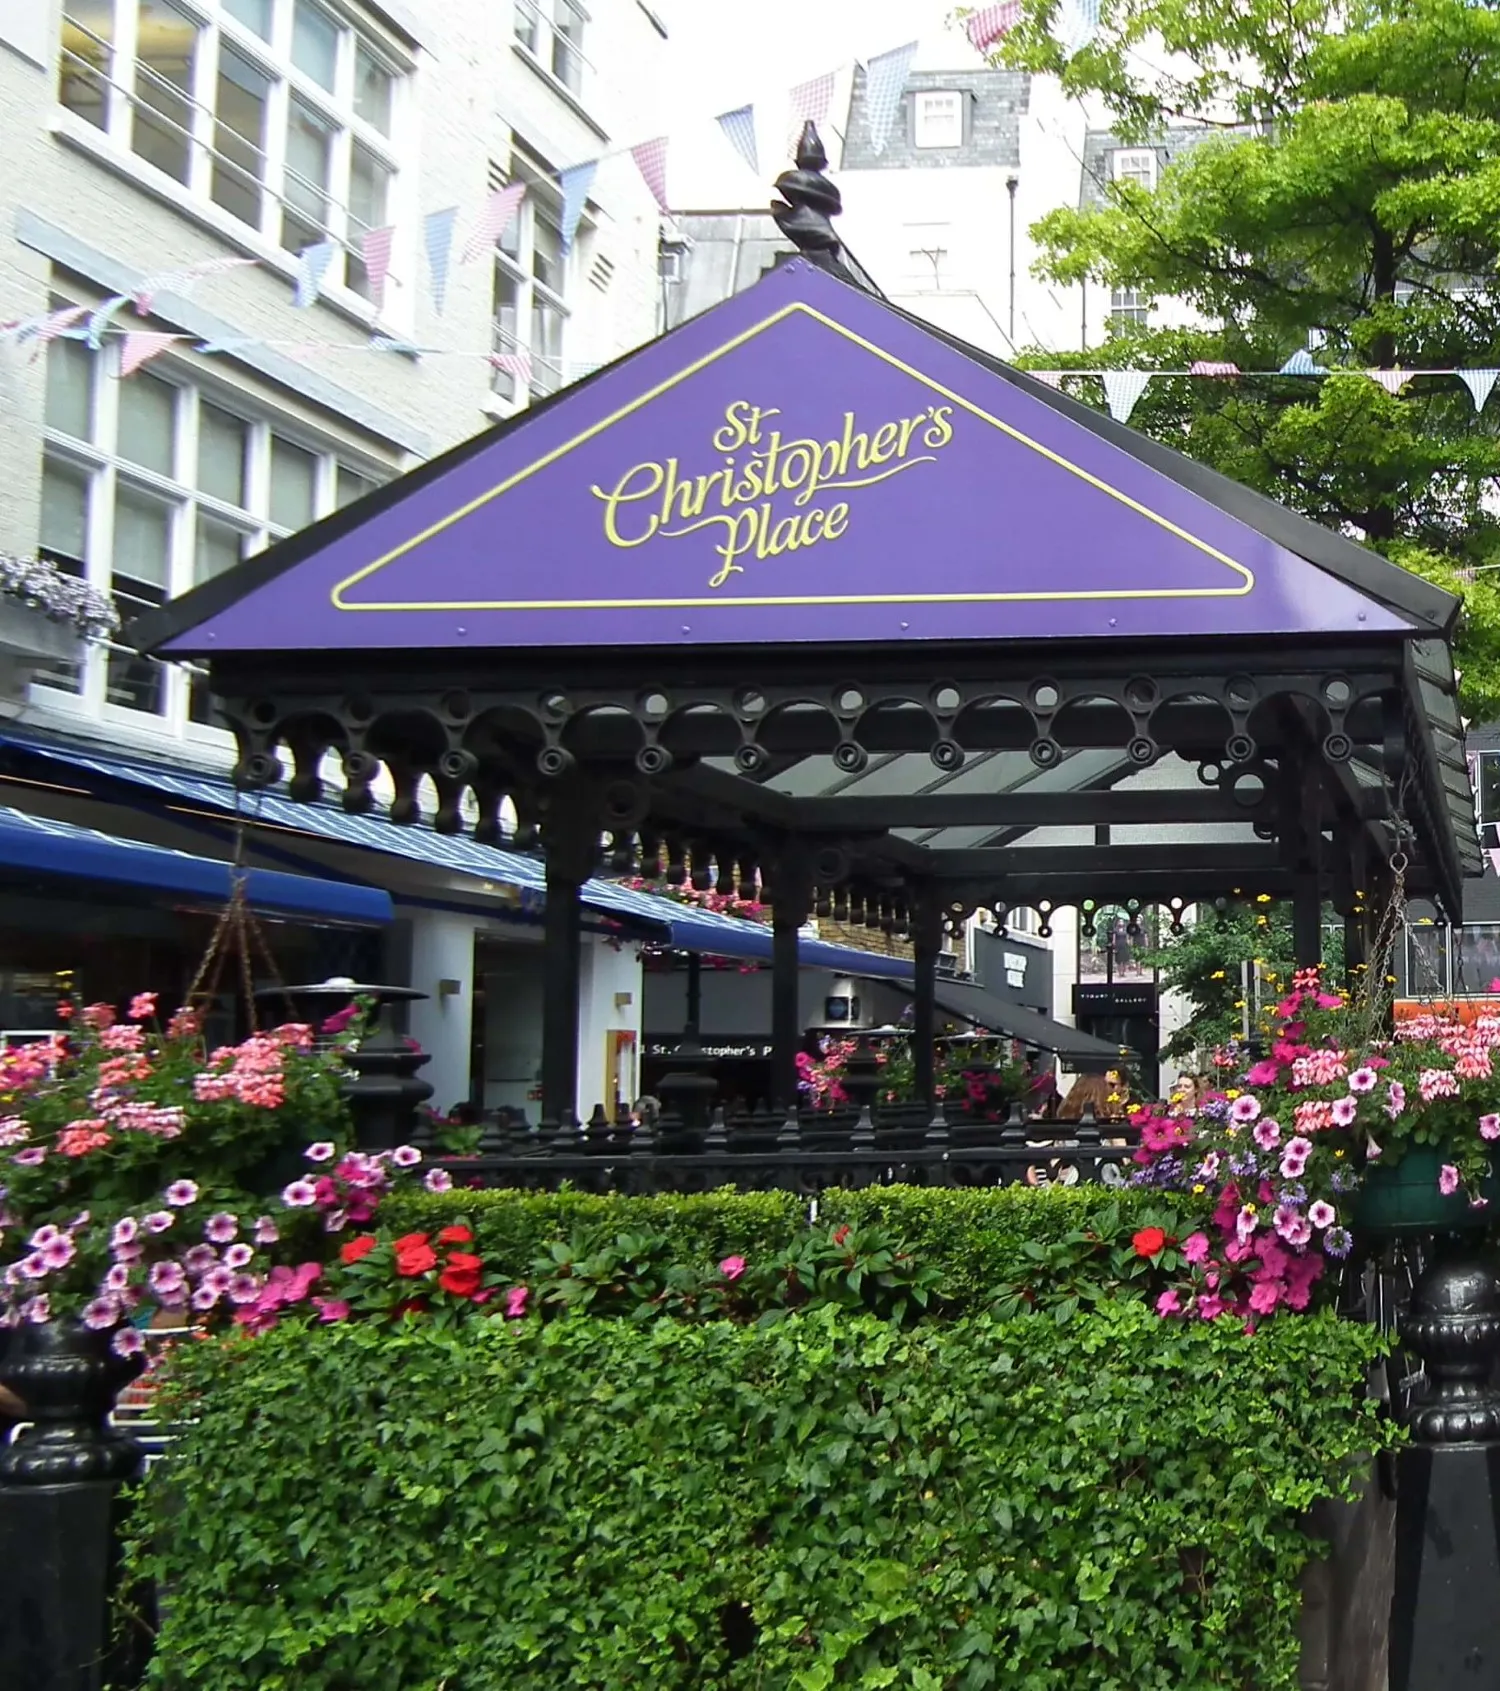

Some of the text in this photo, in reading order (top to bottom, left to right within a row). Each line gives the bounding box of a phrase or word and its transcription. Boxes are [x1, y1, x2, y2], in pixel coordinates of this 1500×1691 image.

[712, 400, 781, 452] St
[590, 405, 954, 548] Christopher's
[657, 502, 849, 588] Place
